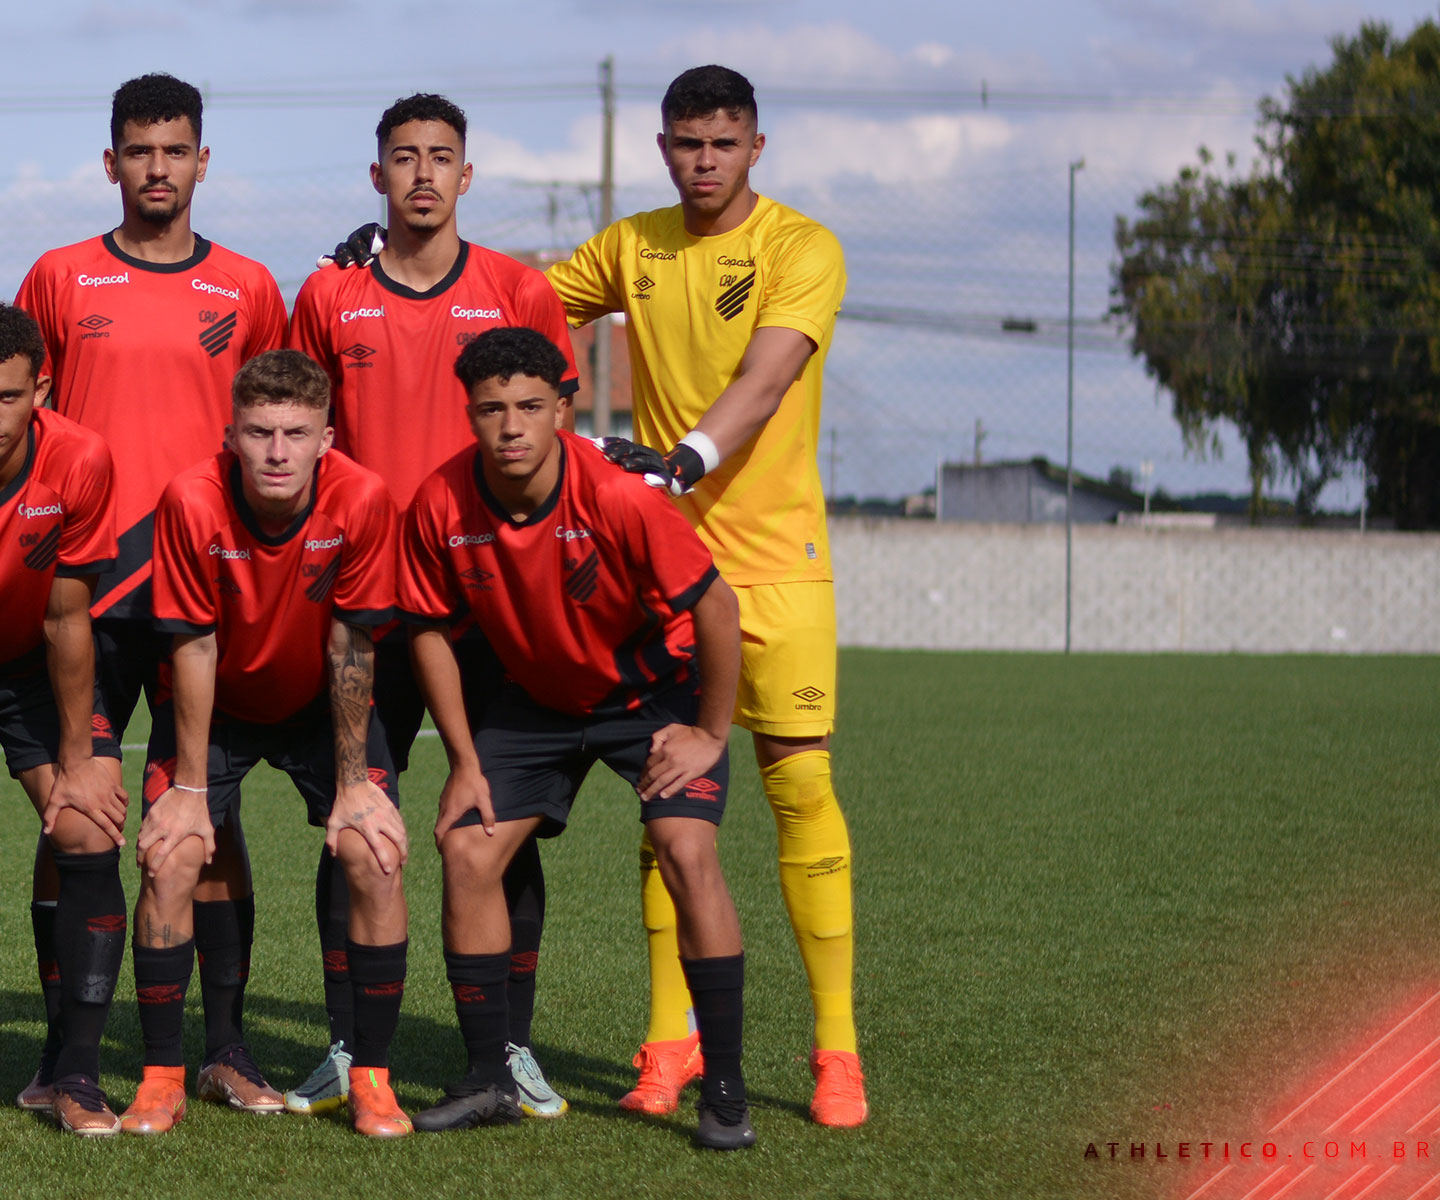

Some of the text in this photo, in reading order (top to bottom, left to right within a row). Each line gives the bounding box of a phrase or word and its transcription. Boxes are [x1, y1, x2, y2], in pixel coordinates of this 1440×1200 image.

[78, 271, 130, 287] Copacol
[719, 274, 738, 288] CAP
[191, 278, 240, 300] Copacol
[198, 310, 220, 324] CAP
[451, 305, 502, 321] Copacol
[81, 330, 110, 340] umbro
[304, 533, 344, 552] opacol
[795, 703, 822, 711] umbro
